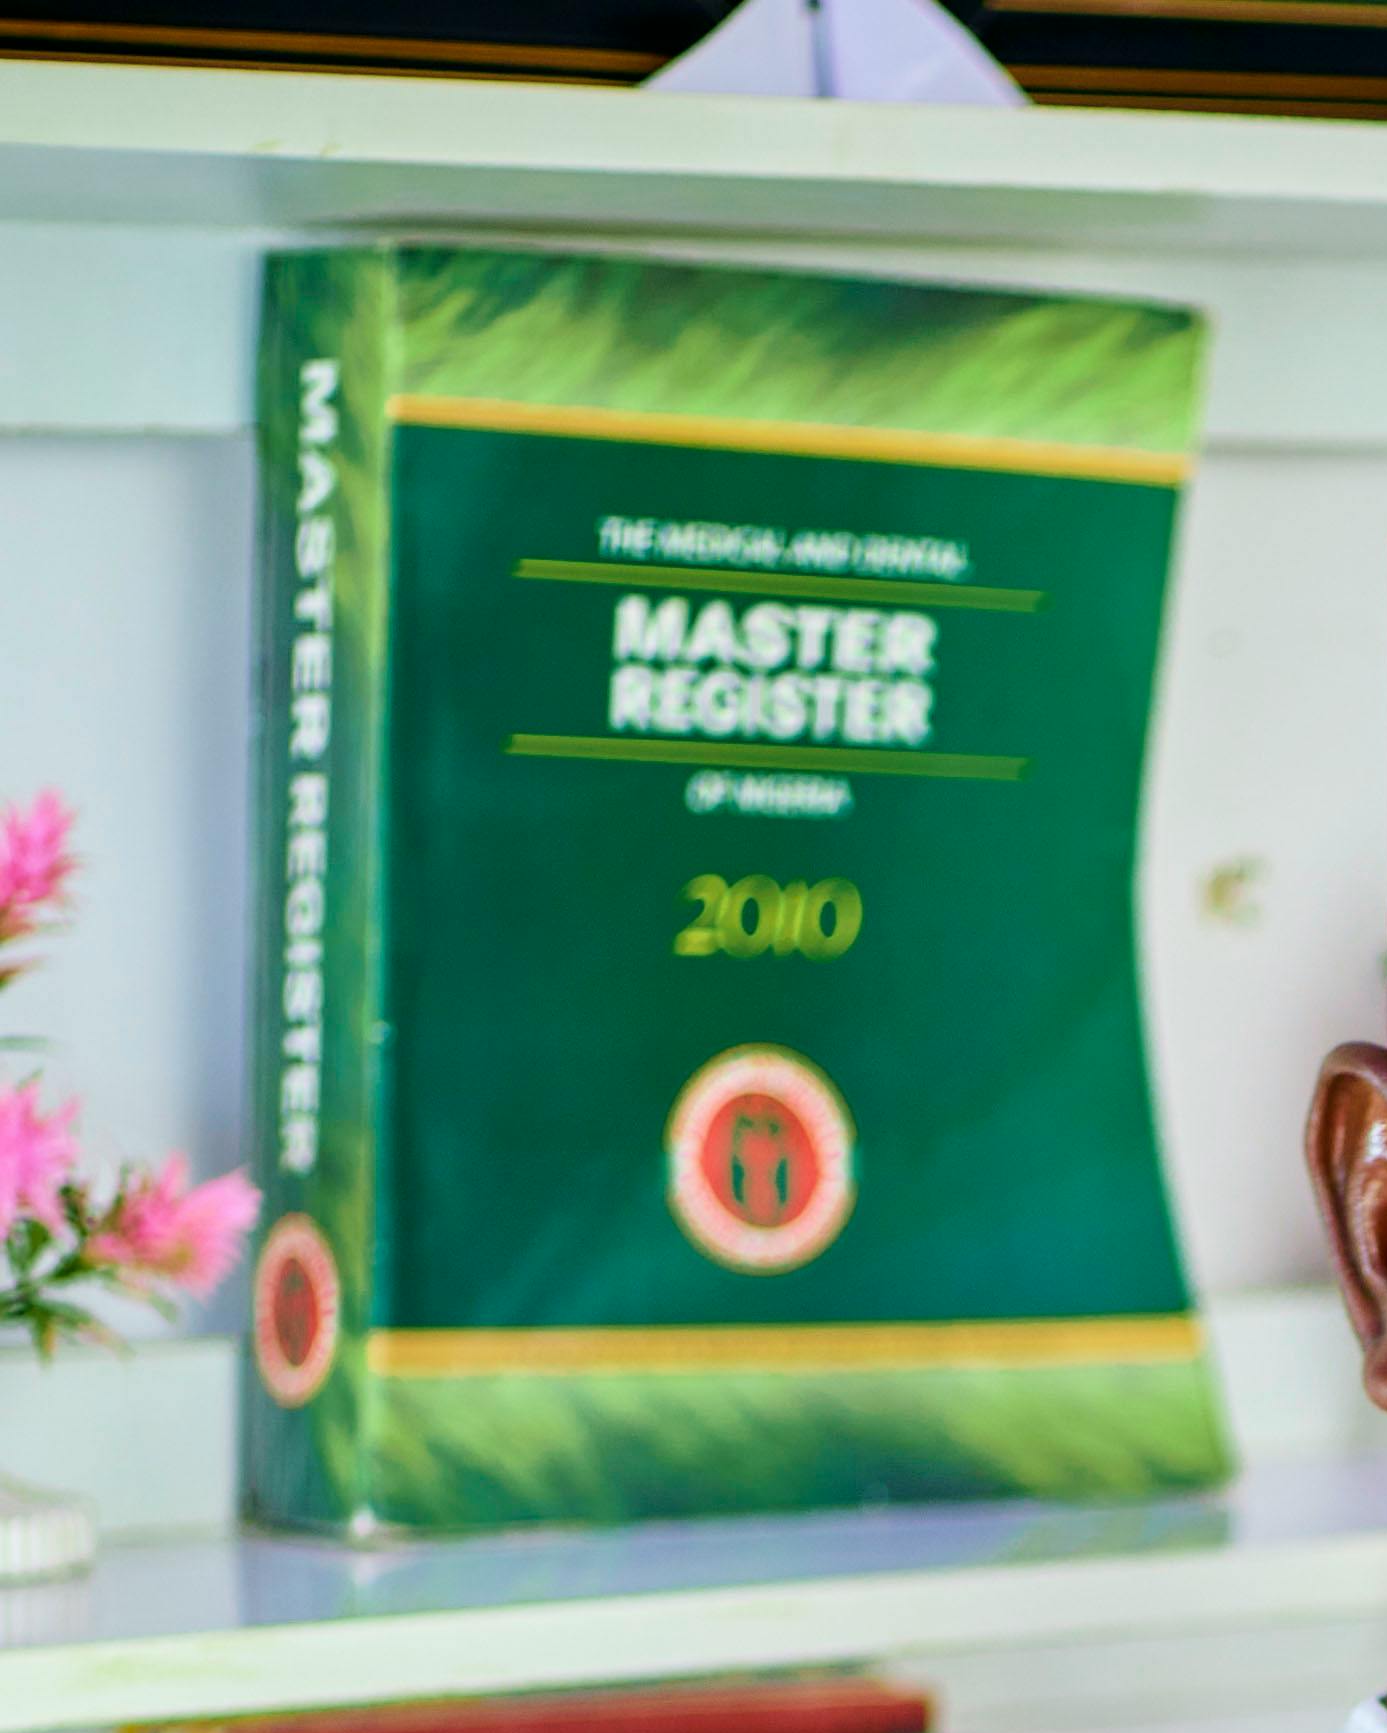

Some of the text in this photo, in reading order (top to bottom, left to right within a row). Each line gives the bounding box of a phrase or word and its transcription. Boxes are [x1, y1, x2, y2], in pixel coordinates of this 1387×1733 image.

[598, 515, 655, 560] THE
[613, 594, 938, 676] MASTER
[608, 663, 934, 748] REGISTER
[280, 357, 340, 1179] MASTER REGISTER
[685, 768, 730, 814] OF
[673, 873, 863, 962] 2010
